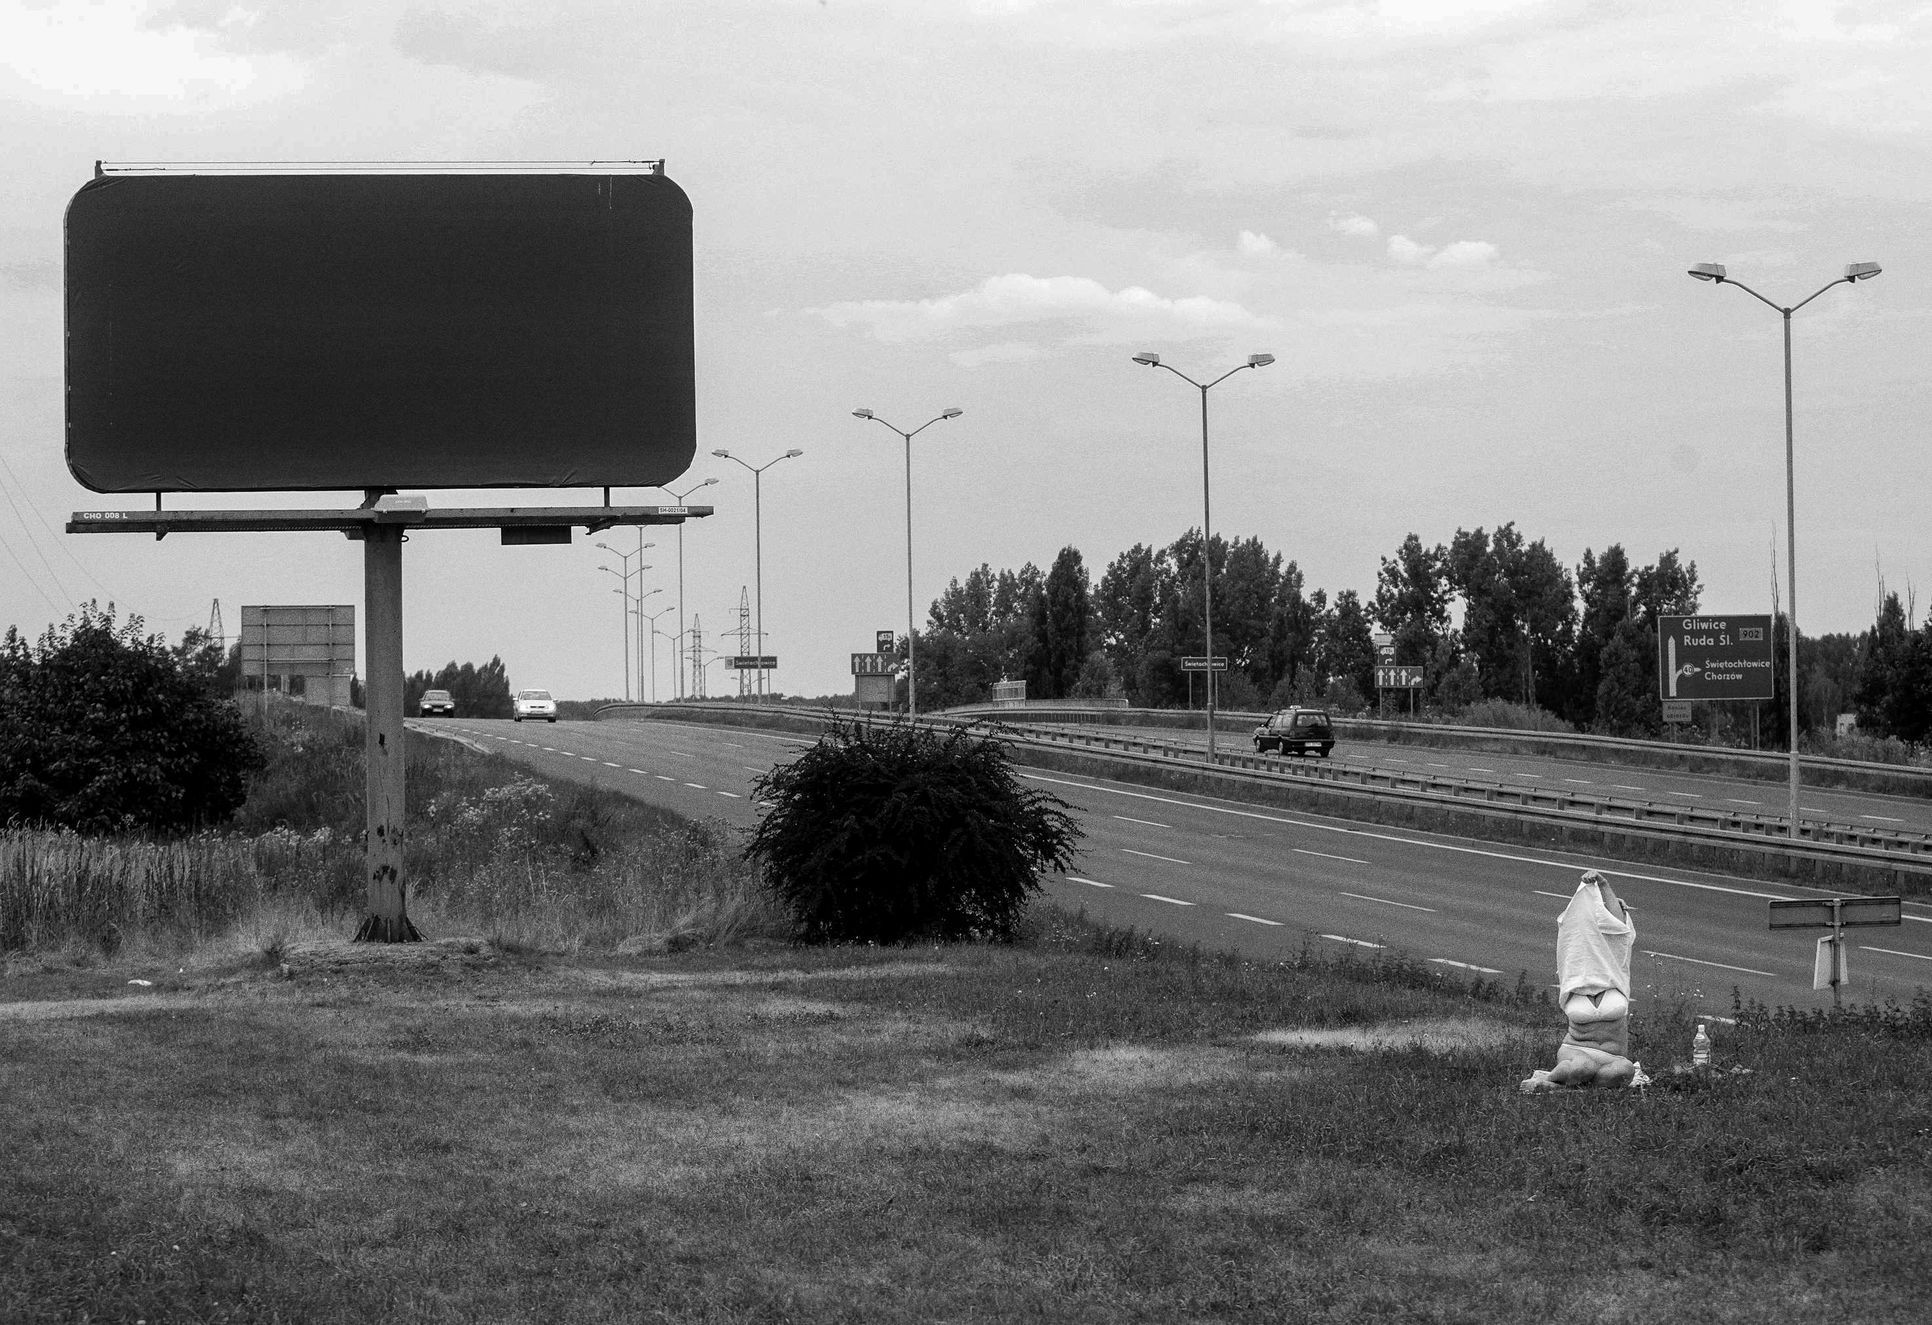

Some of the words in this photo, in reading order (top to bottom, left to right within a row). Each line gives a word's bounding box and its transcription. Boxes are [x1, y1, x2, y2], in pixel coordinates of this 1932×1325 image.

[1682, 619, 1727, 630] Gliwice
[1683, 635, 1714, 646] Ruda
[1719, 632, 1734, 646] Śl.
[1742, 630, 1760, 639] 902
[1705, 658, 1771, 669] Świętochłowice
[1704, 672, 1743, 680] Chorzów
